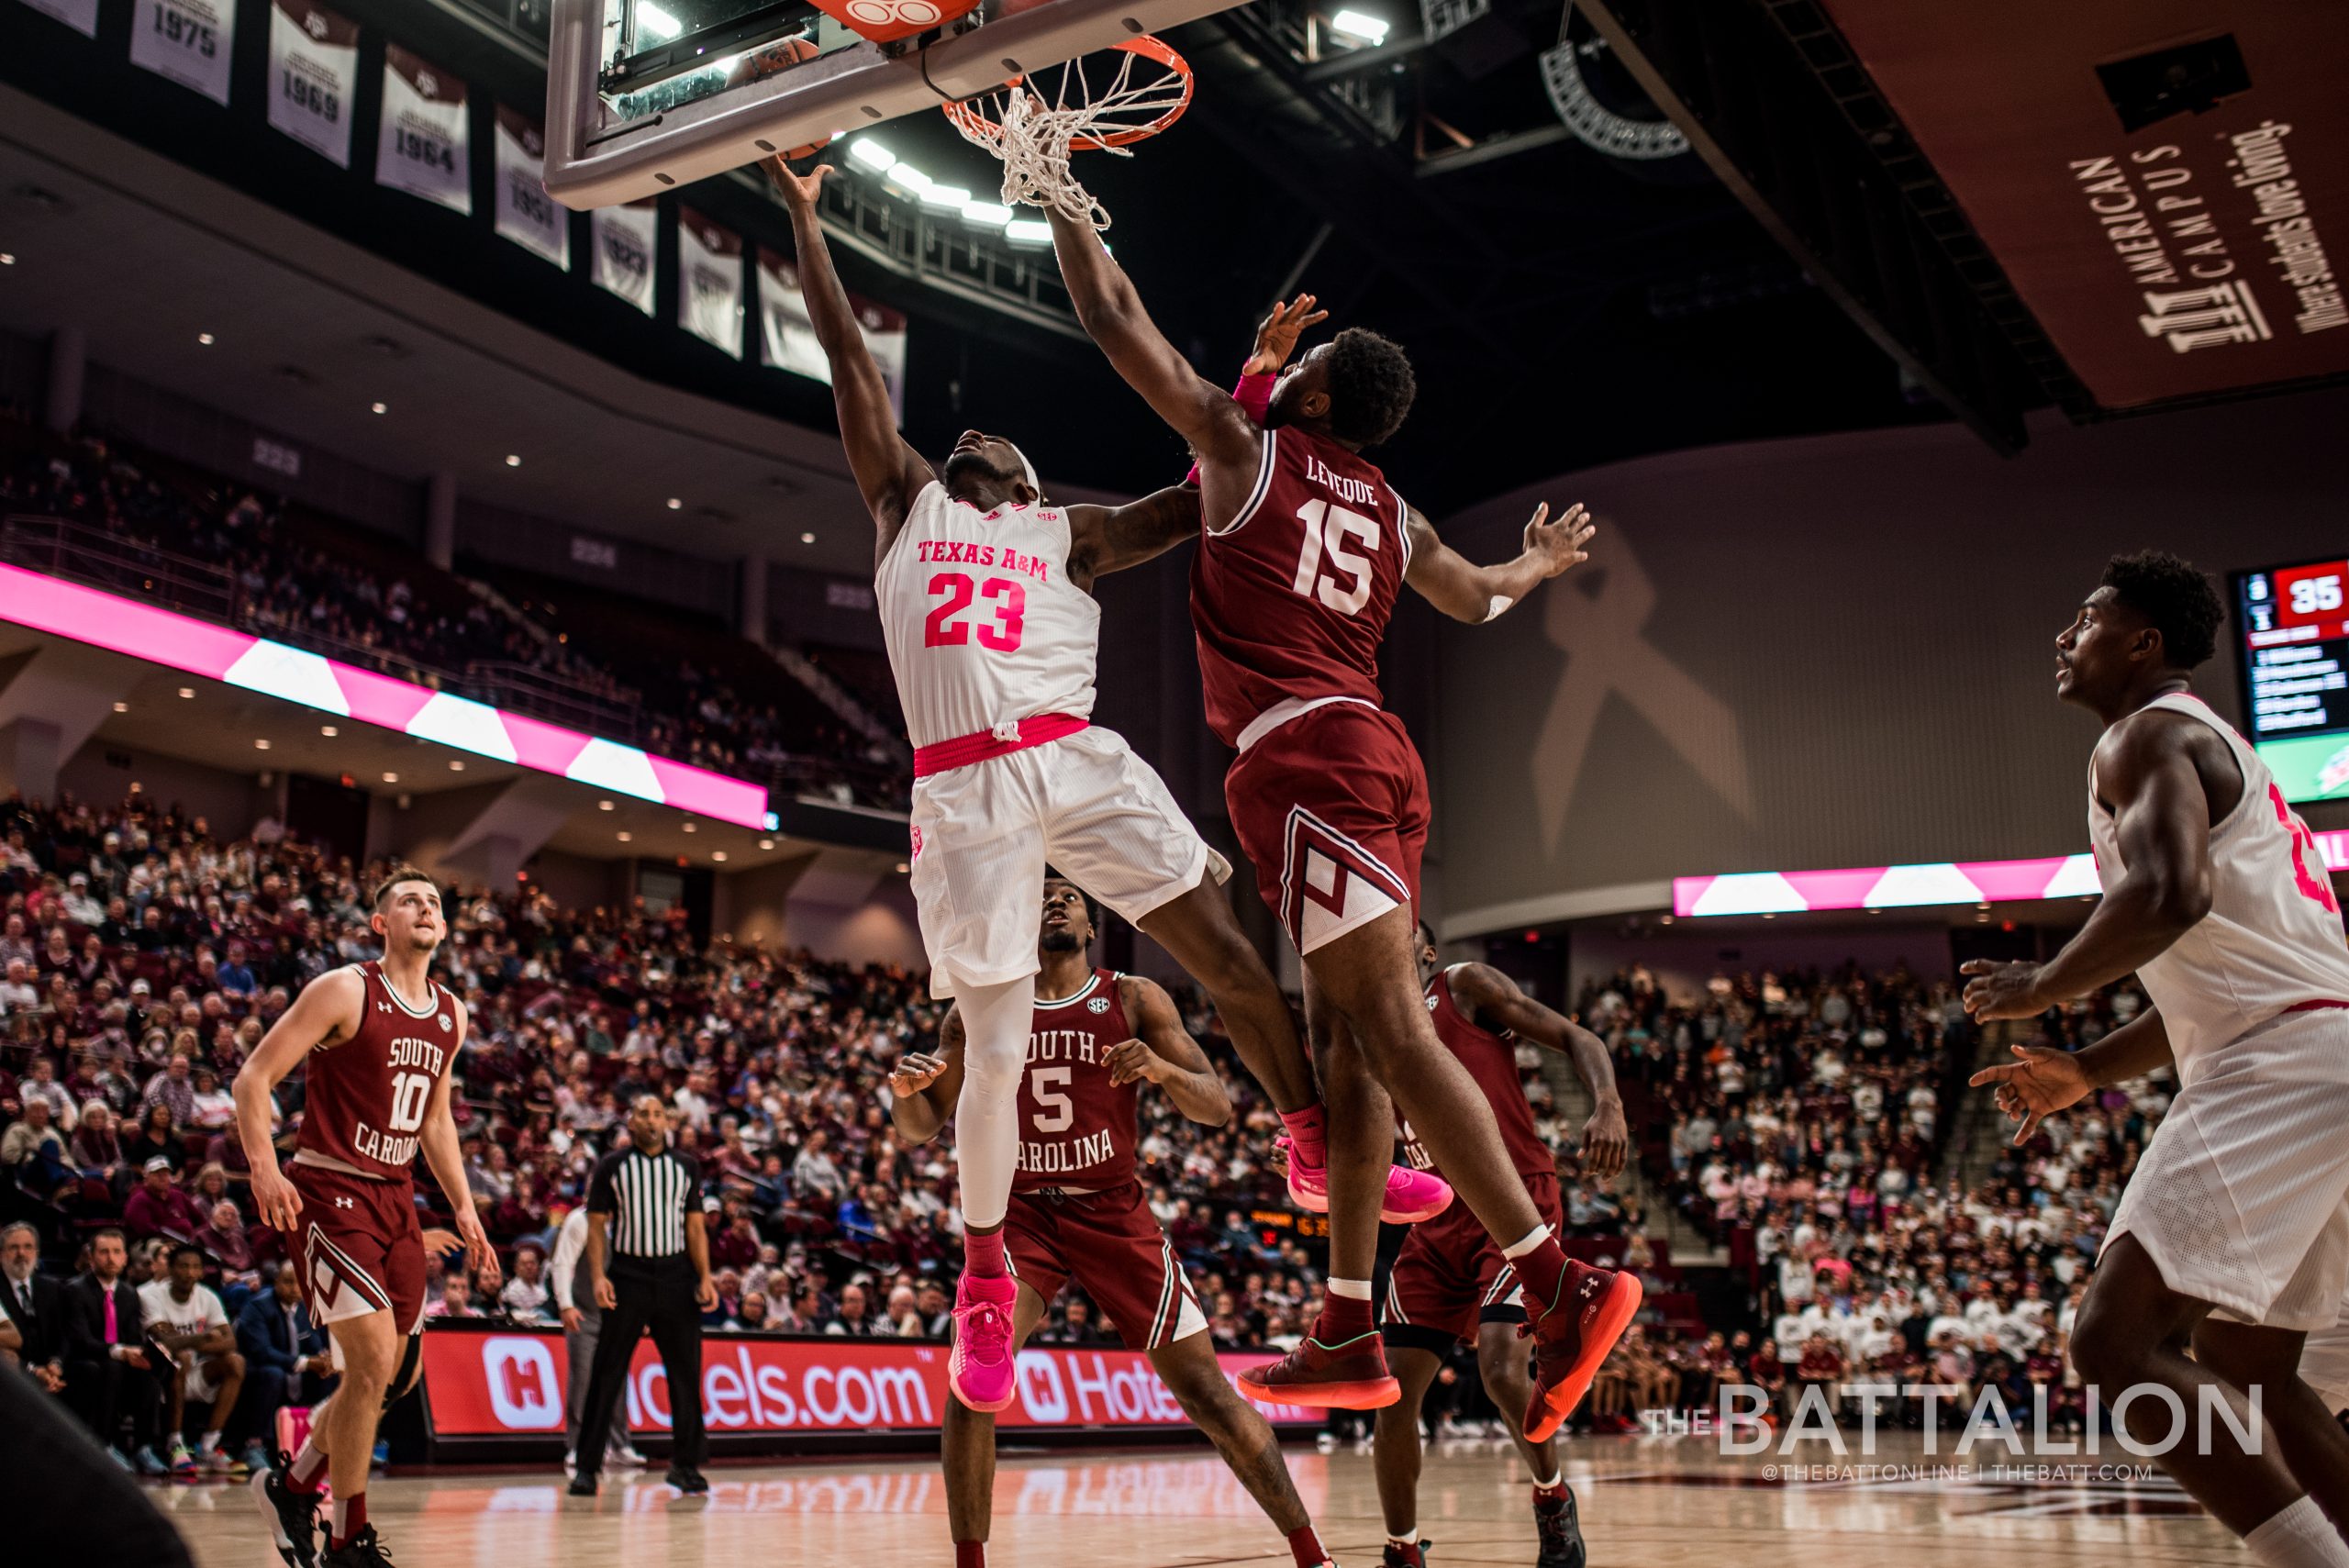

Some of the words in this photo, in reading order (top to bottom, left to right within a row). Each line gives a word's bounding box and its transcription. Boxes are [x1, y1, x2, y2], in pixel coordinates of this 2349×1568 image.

[153, 3, 217, 60] 1975
[283, 69, 339, 125] 1969
[2068, 155, 2180, 284] AMERICAN
[2131, 144, 2235, 279] CAMPUS
[2251, 179, 2306, 225] love
[2261, 217, 2333, 287] students
[2295, 282, 2349, 334] Where
[1306, 455, 1378, 506] LEVEQUE
[918, 539, 996, 566] TEXAS
[1000, 548, 1048, 583] A&M
[1293, 497, 1380, 617] 15
[924, 573, 1026, 653] 23
[2288, 574, 2343, 615] 35
[1088, 998, 1109, 1014] SEC
[386, 1037, 444, 1078] SOUTH
[1024, 1029, 1096, 1065] OUTH
[388, 1071, 431, 1133] 10
[1030, 1066, 1074, 1133] 5
[1017, 1128, 1116, 1173] AROLINA
